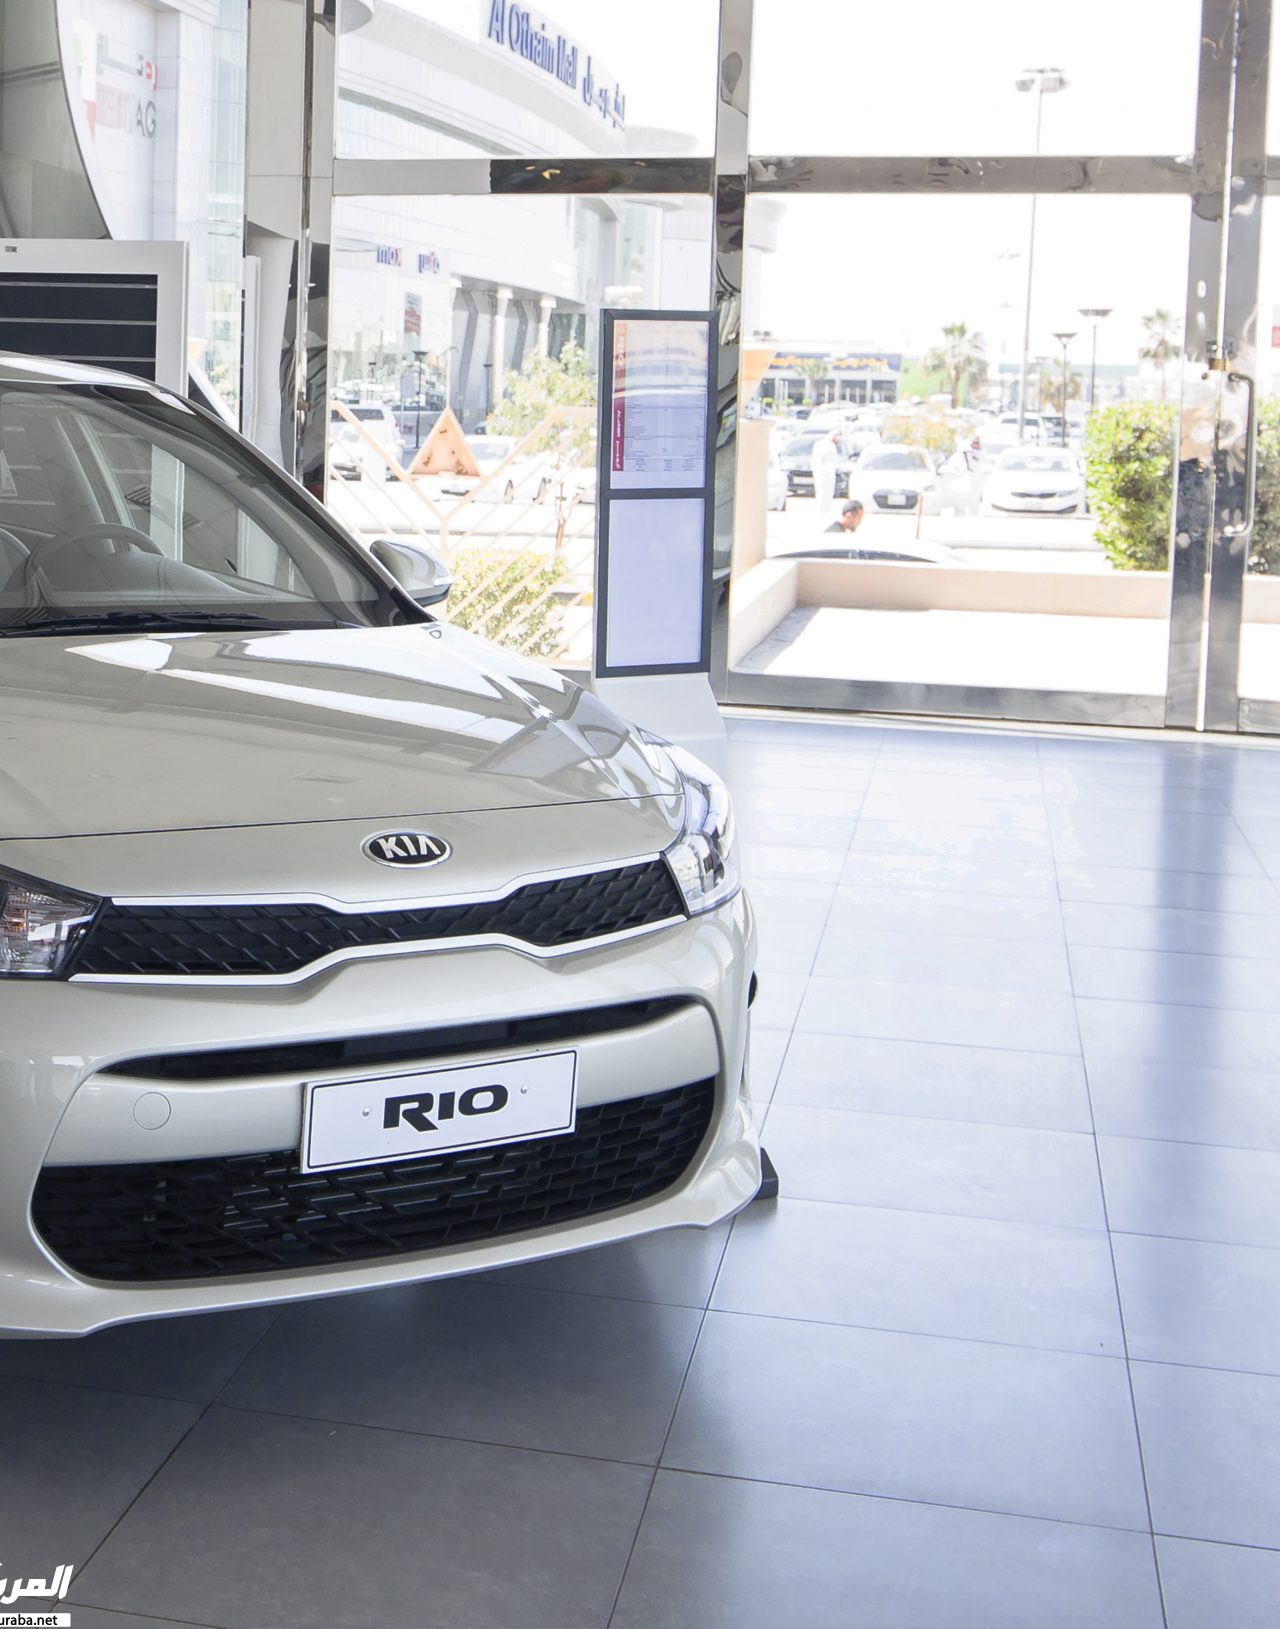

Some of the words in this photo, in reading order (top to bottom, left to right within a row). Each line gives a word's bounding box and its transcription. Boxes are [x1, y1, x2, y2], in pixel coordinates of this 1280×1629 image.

[487, 0, 505, 44] Al
[376, 834, 442, 860] KIA
[382, 1084, 509, 1133] RIO
